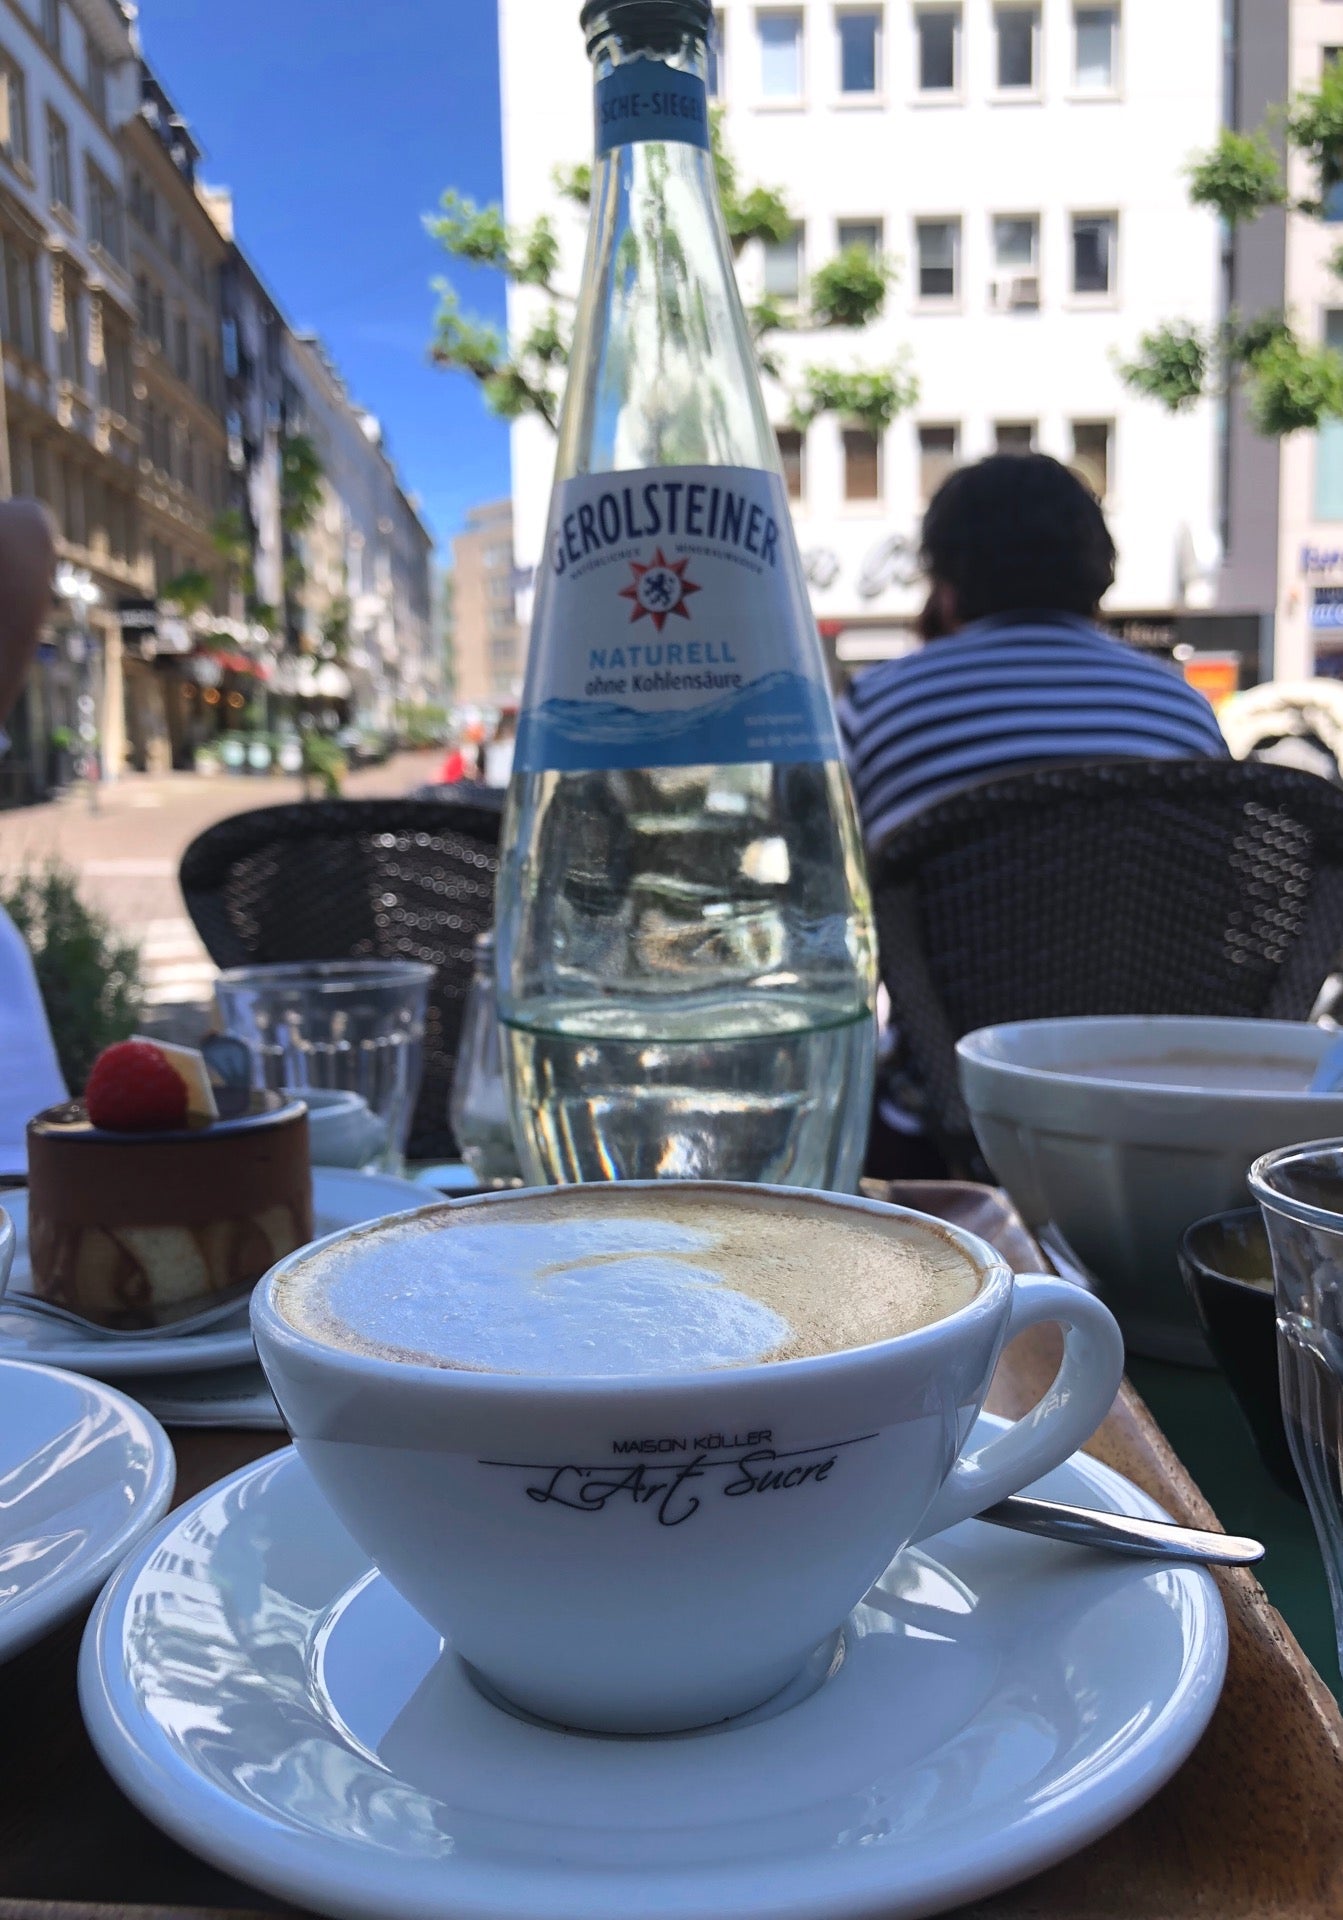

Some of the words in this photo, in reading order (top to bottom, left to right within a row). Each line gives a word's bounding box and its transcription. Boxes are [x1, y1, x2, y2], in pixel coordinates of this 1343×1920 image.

[589, 641, 736, 671] NATURELL
[585, 677, 626, 697] ohne
[631, 671, 743, 693] Kohlensäure
[612, 1437, 688, 1454] MAISON
[693, 1429, 773, 1449] KÖLLER
[724, 1450, 838, 1497] Sucré
